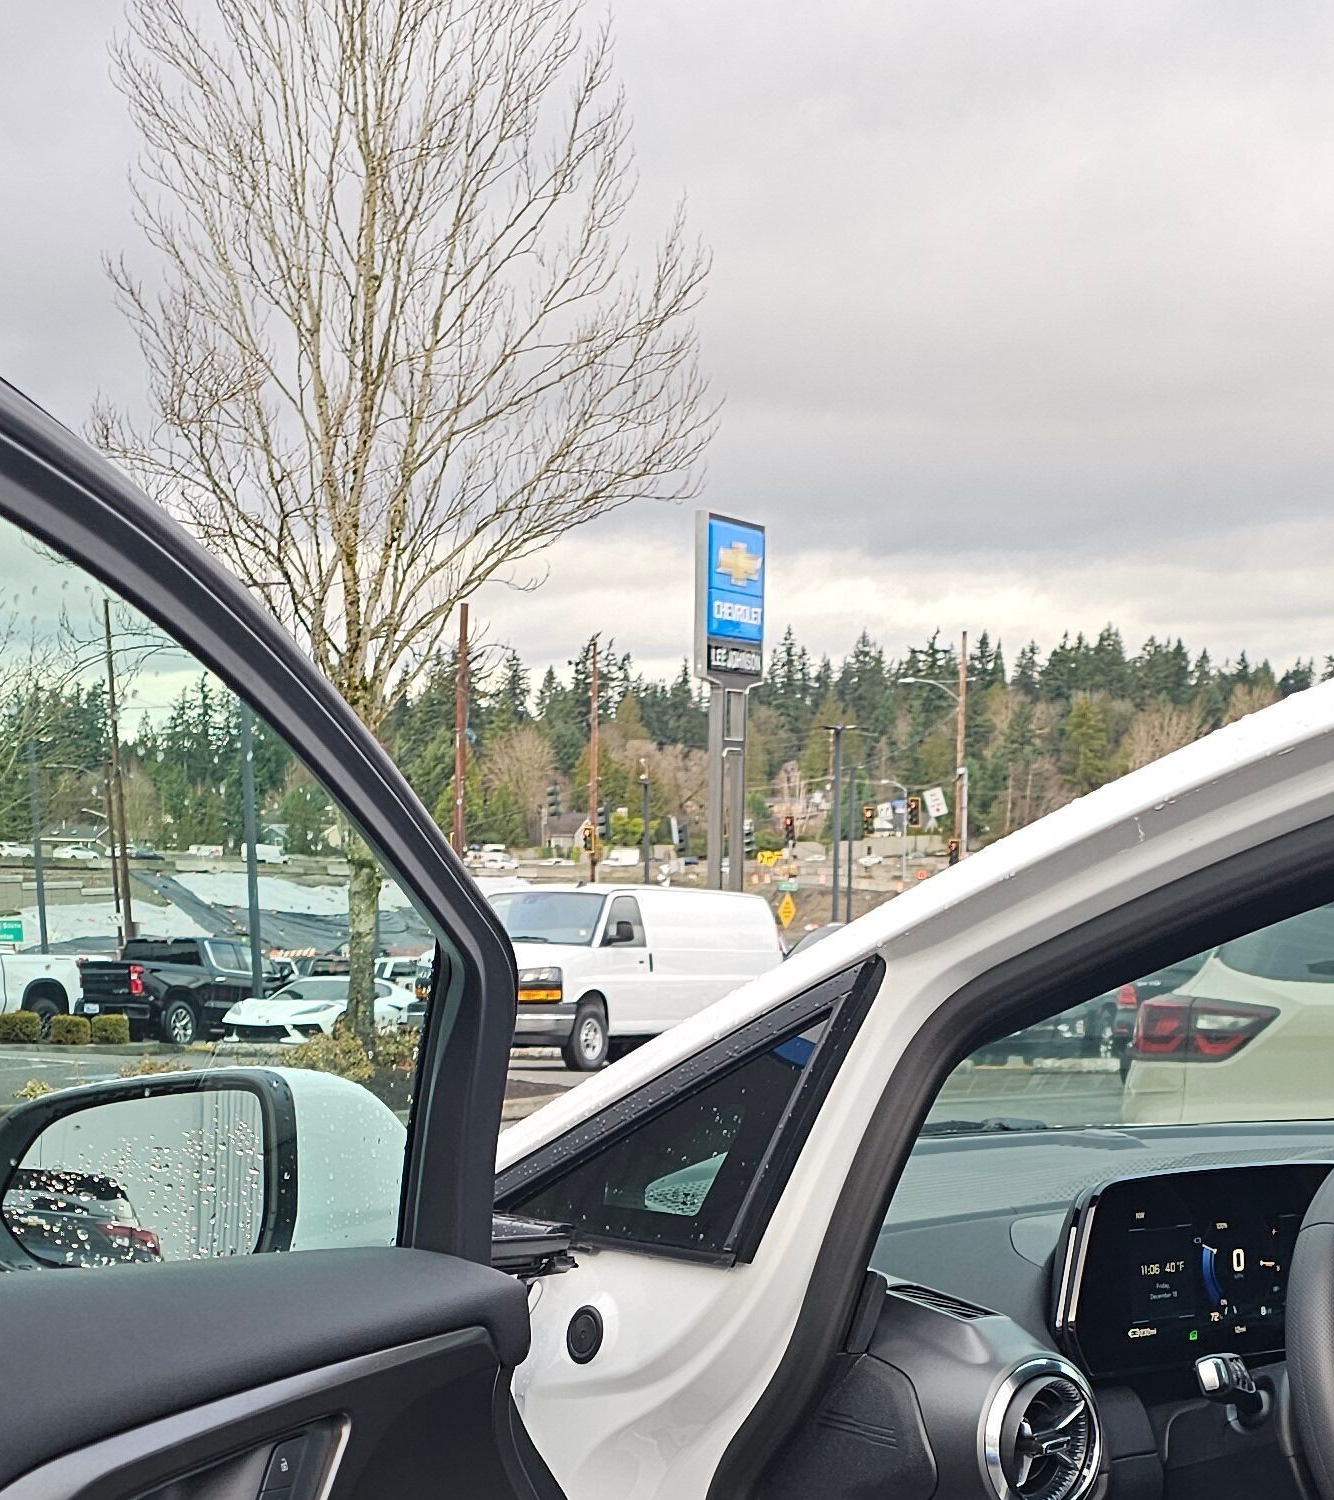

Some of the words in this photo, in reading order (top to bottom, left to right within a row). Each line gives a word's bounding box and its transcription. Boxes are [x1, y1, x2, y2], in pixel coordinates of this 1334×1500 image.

[713, 600, 762, 625] CHEVROLET
[711, 648, 727, 666] LEE
[727, 650, 761, 671] JOHNSON
[1140, 1264, 1161, 1276] 11:06
[1232, 1248, 1245, 1272] 0
